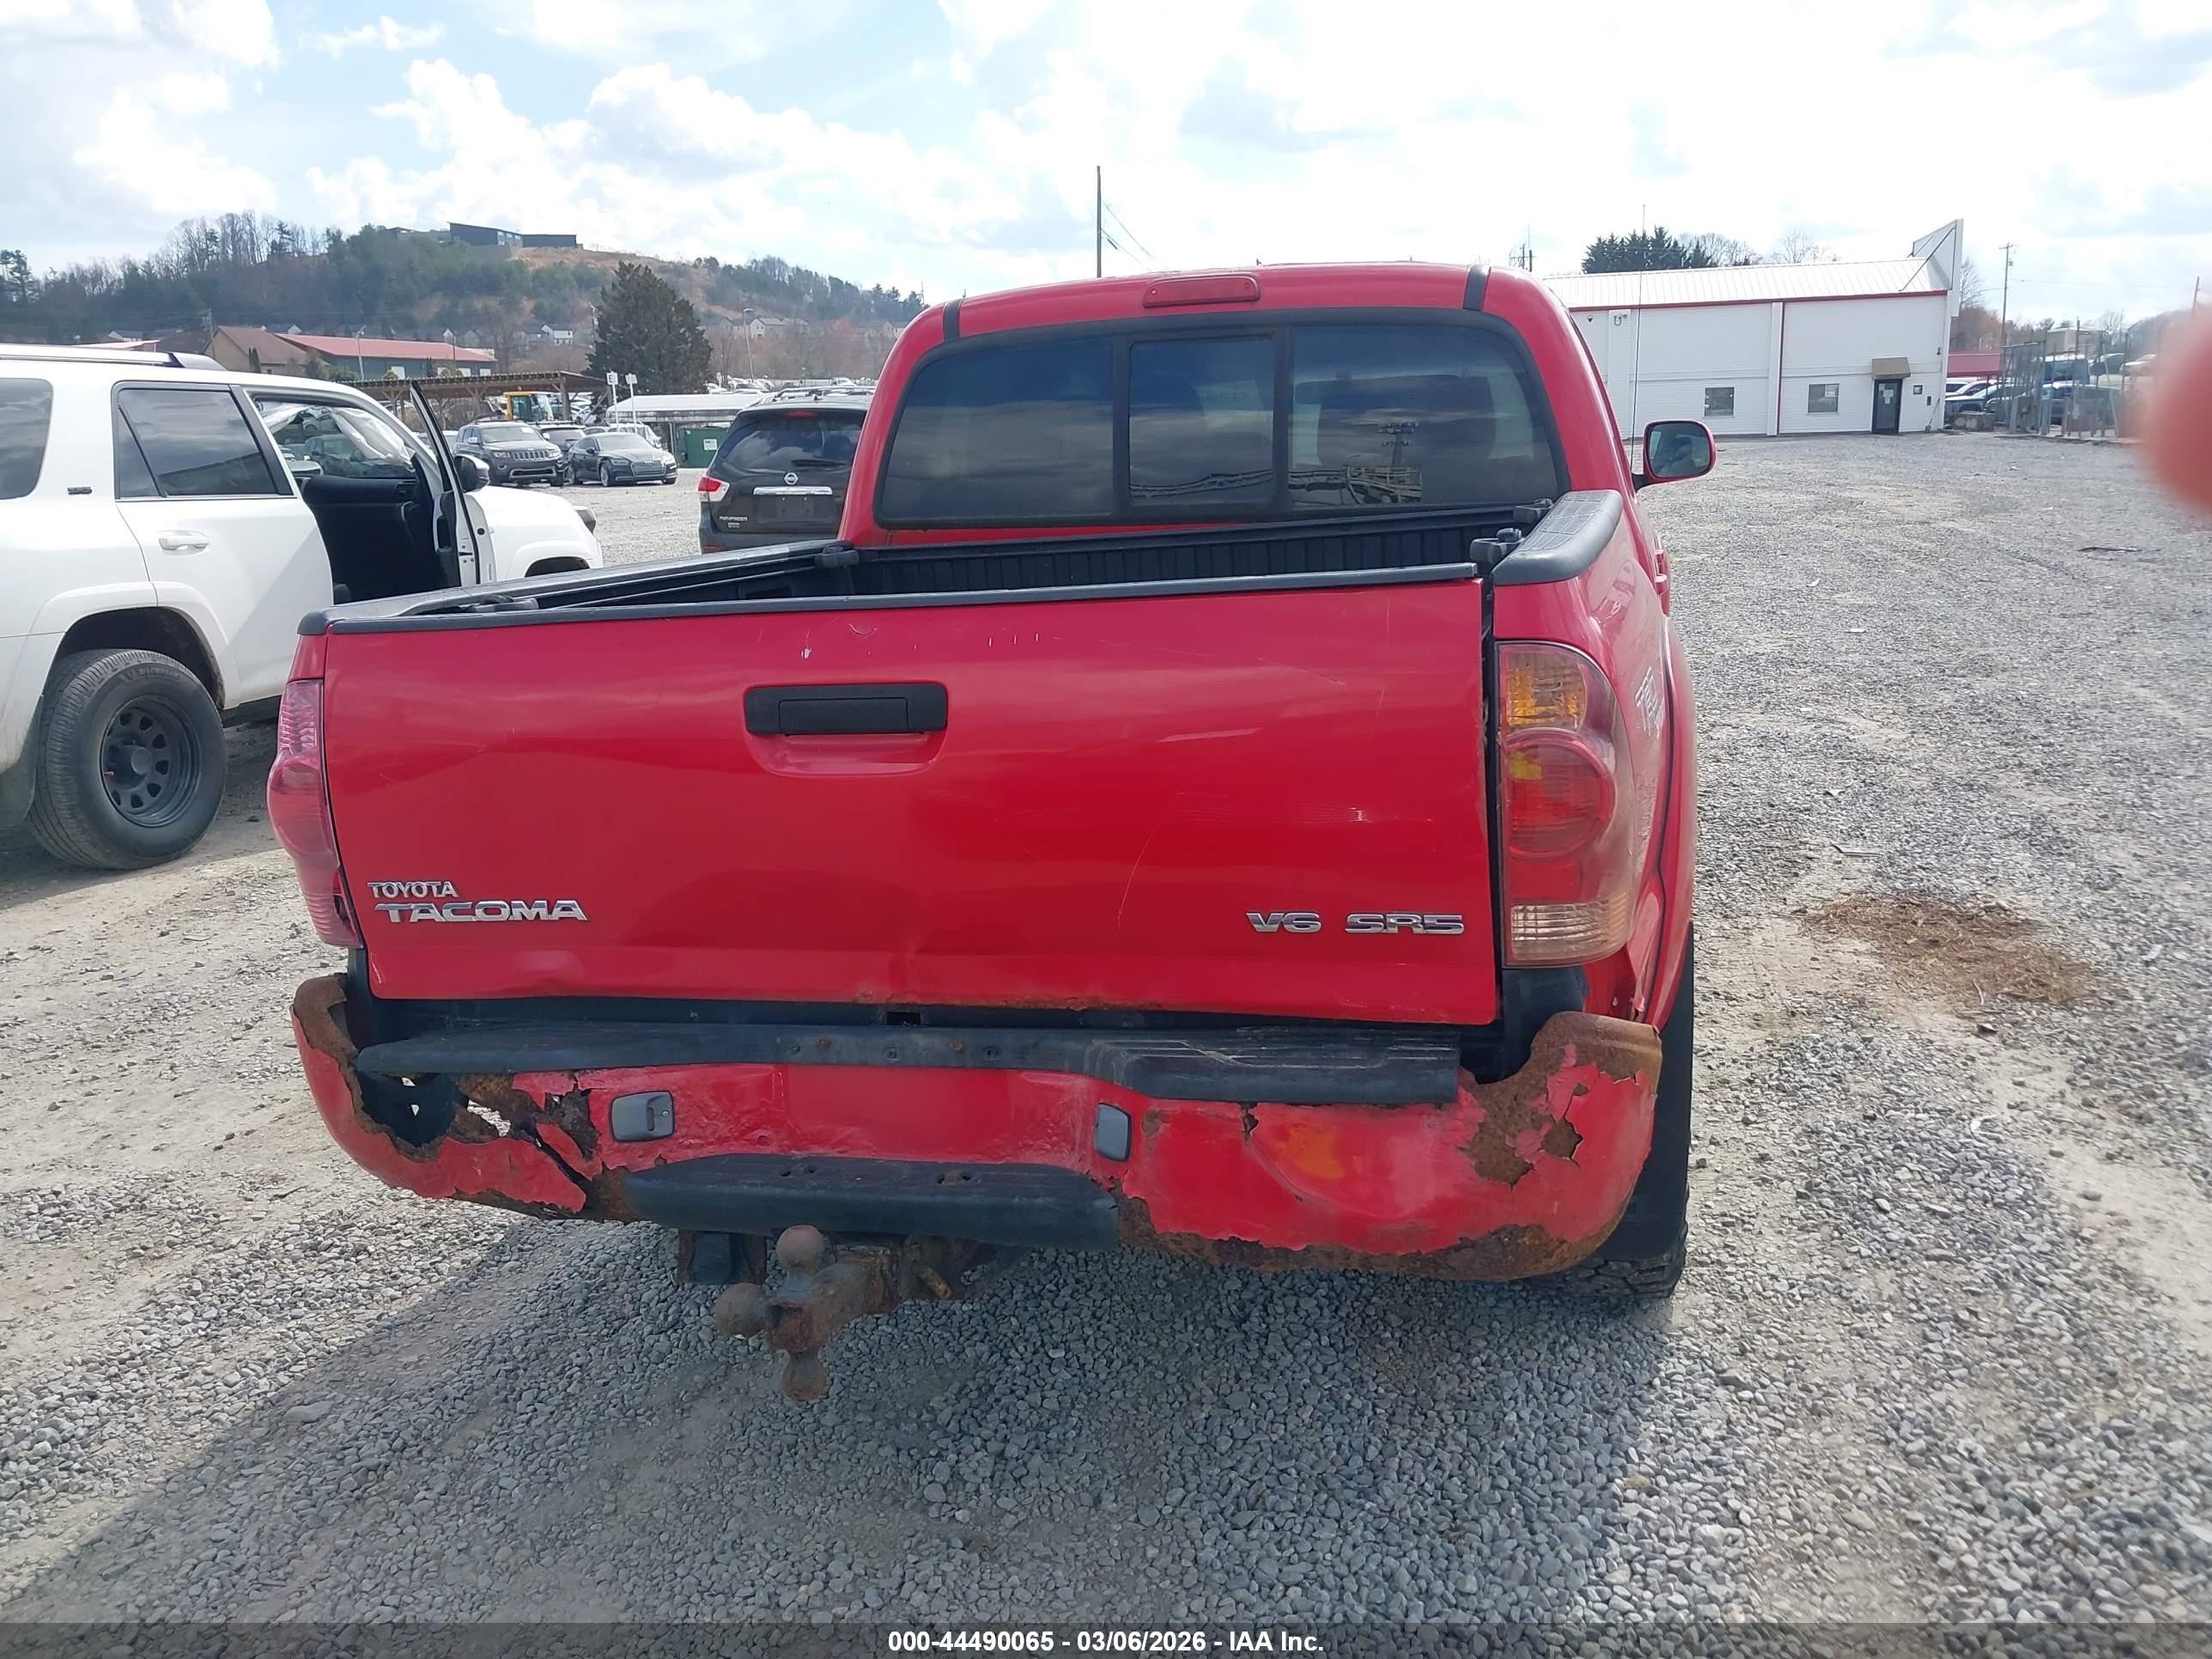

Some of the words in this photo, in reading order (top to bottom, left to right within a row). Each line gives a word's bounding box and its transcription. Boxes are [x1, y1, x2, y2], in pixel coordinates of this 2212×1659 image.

[367, 881, 459, 898] TOYOTA
[374, 900, 588, 922] TACOMA
[1245, 912, 1322, 933] V6
[1345, 913, 1465, 935] SR5
